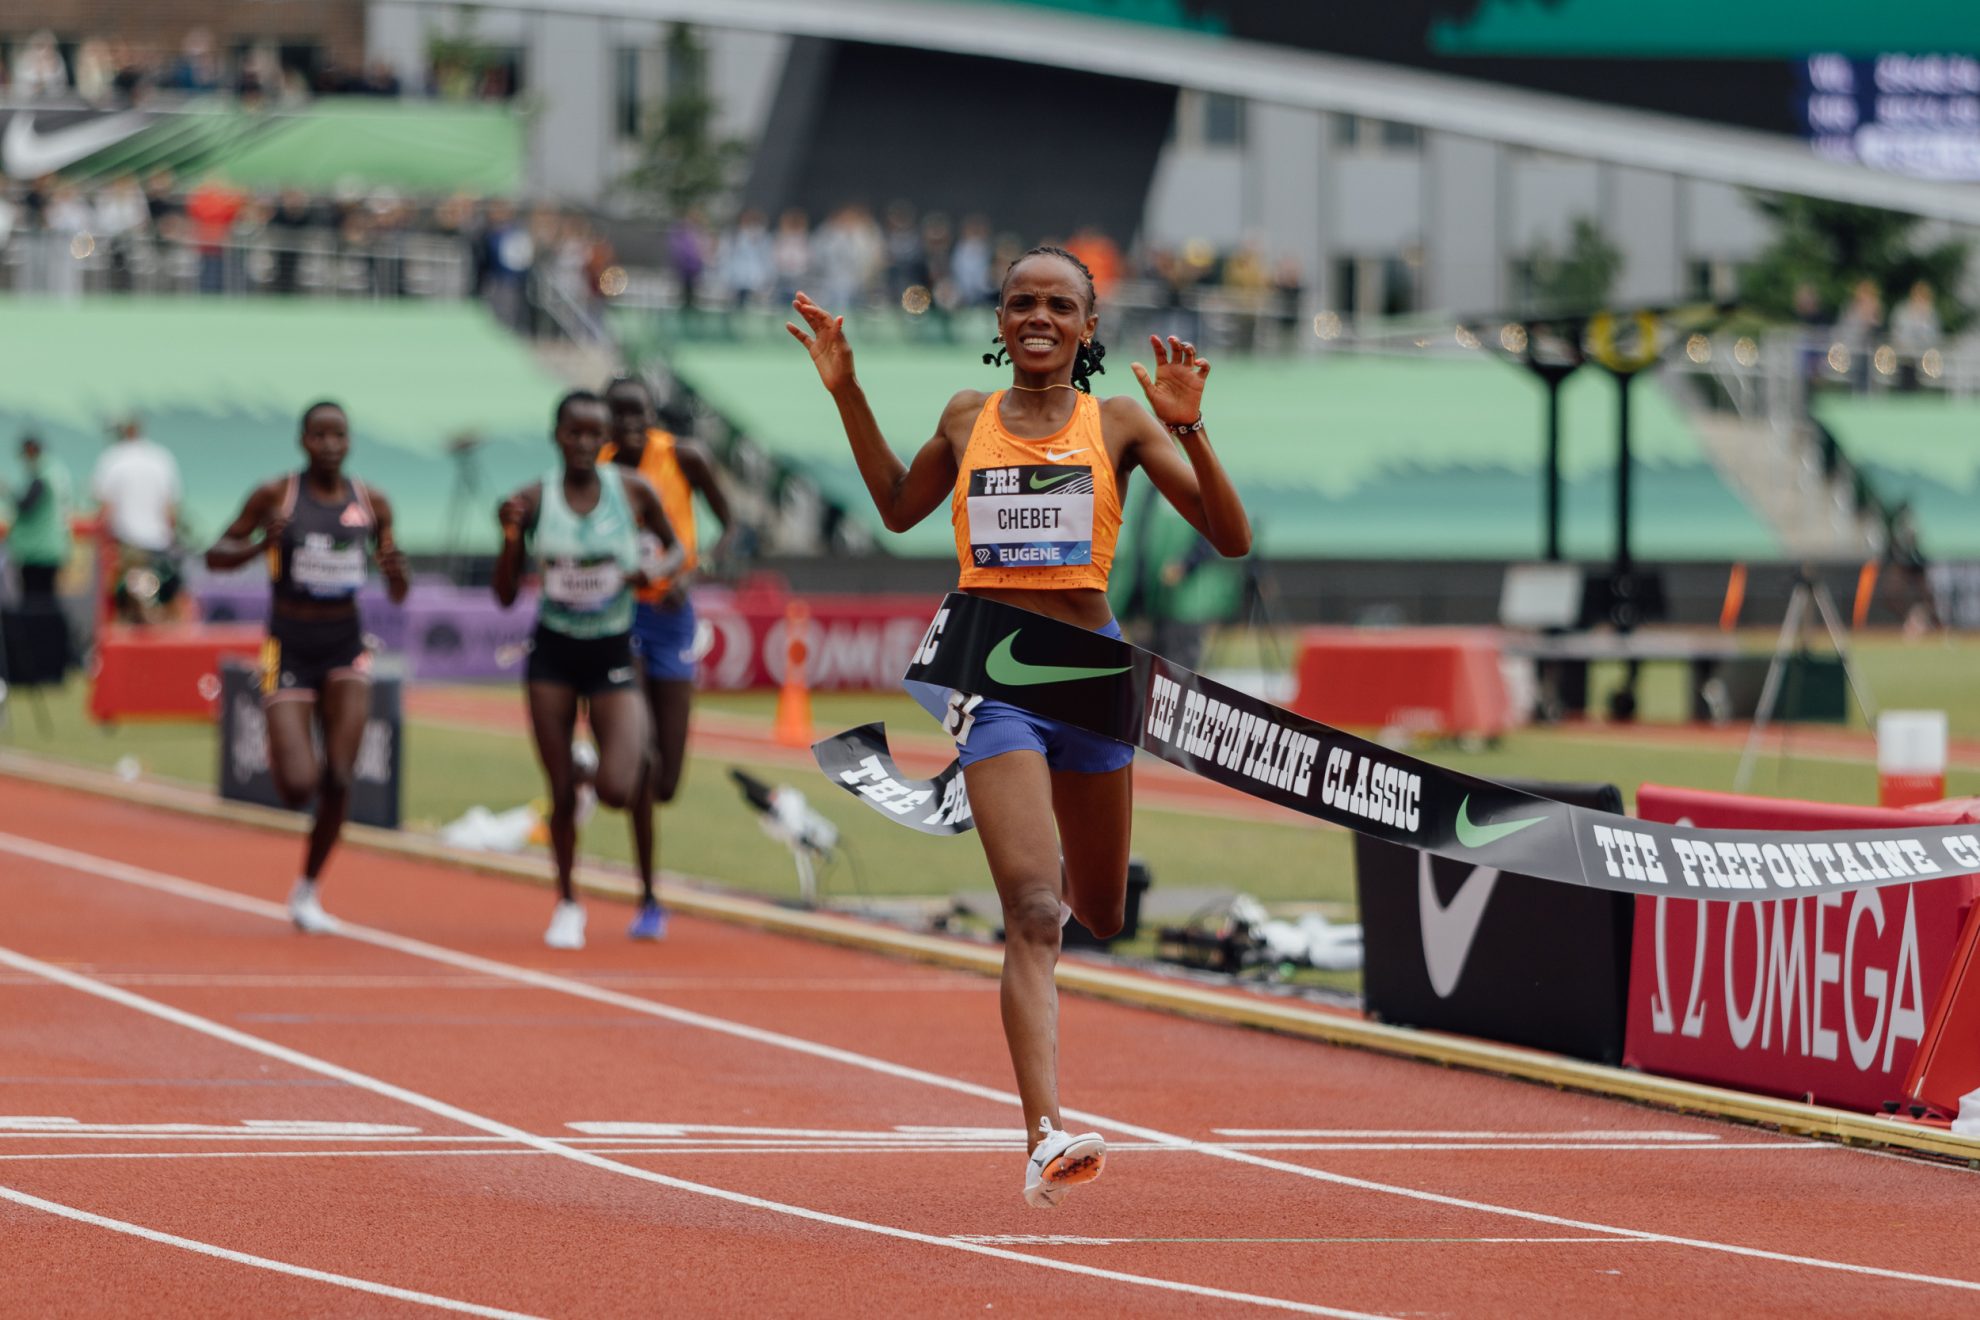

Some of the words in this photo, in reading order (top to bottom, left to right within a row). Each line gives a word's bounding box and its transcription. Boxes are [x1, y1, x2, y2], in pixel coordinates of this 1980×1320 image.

[984, 468, 1020, 495] PRE
[998, 507, 1062, 530] CHEBET
[999, 547, 1061, 562] EUGENE
[1147, 674, 1181, 743] THE
[1176, 689, 1320, 797] PREFONTAINE
[1322, 746, 1421, 833] CLASSIC
[839, 754, 934, 815] THE
[1593, 824, 1668, 884] THE
[1671, 838, 1943, 890] PREFONTAINE
[1723, 882, 1926, 1074] OMEGA
